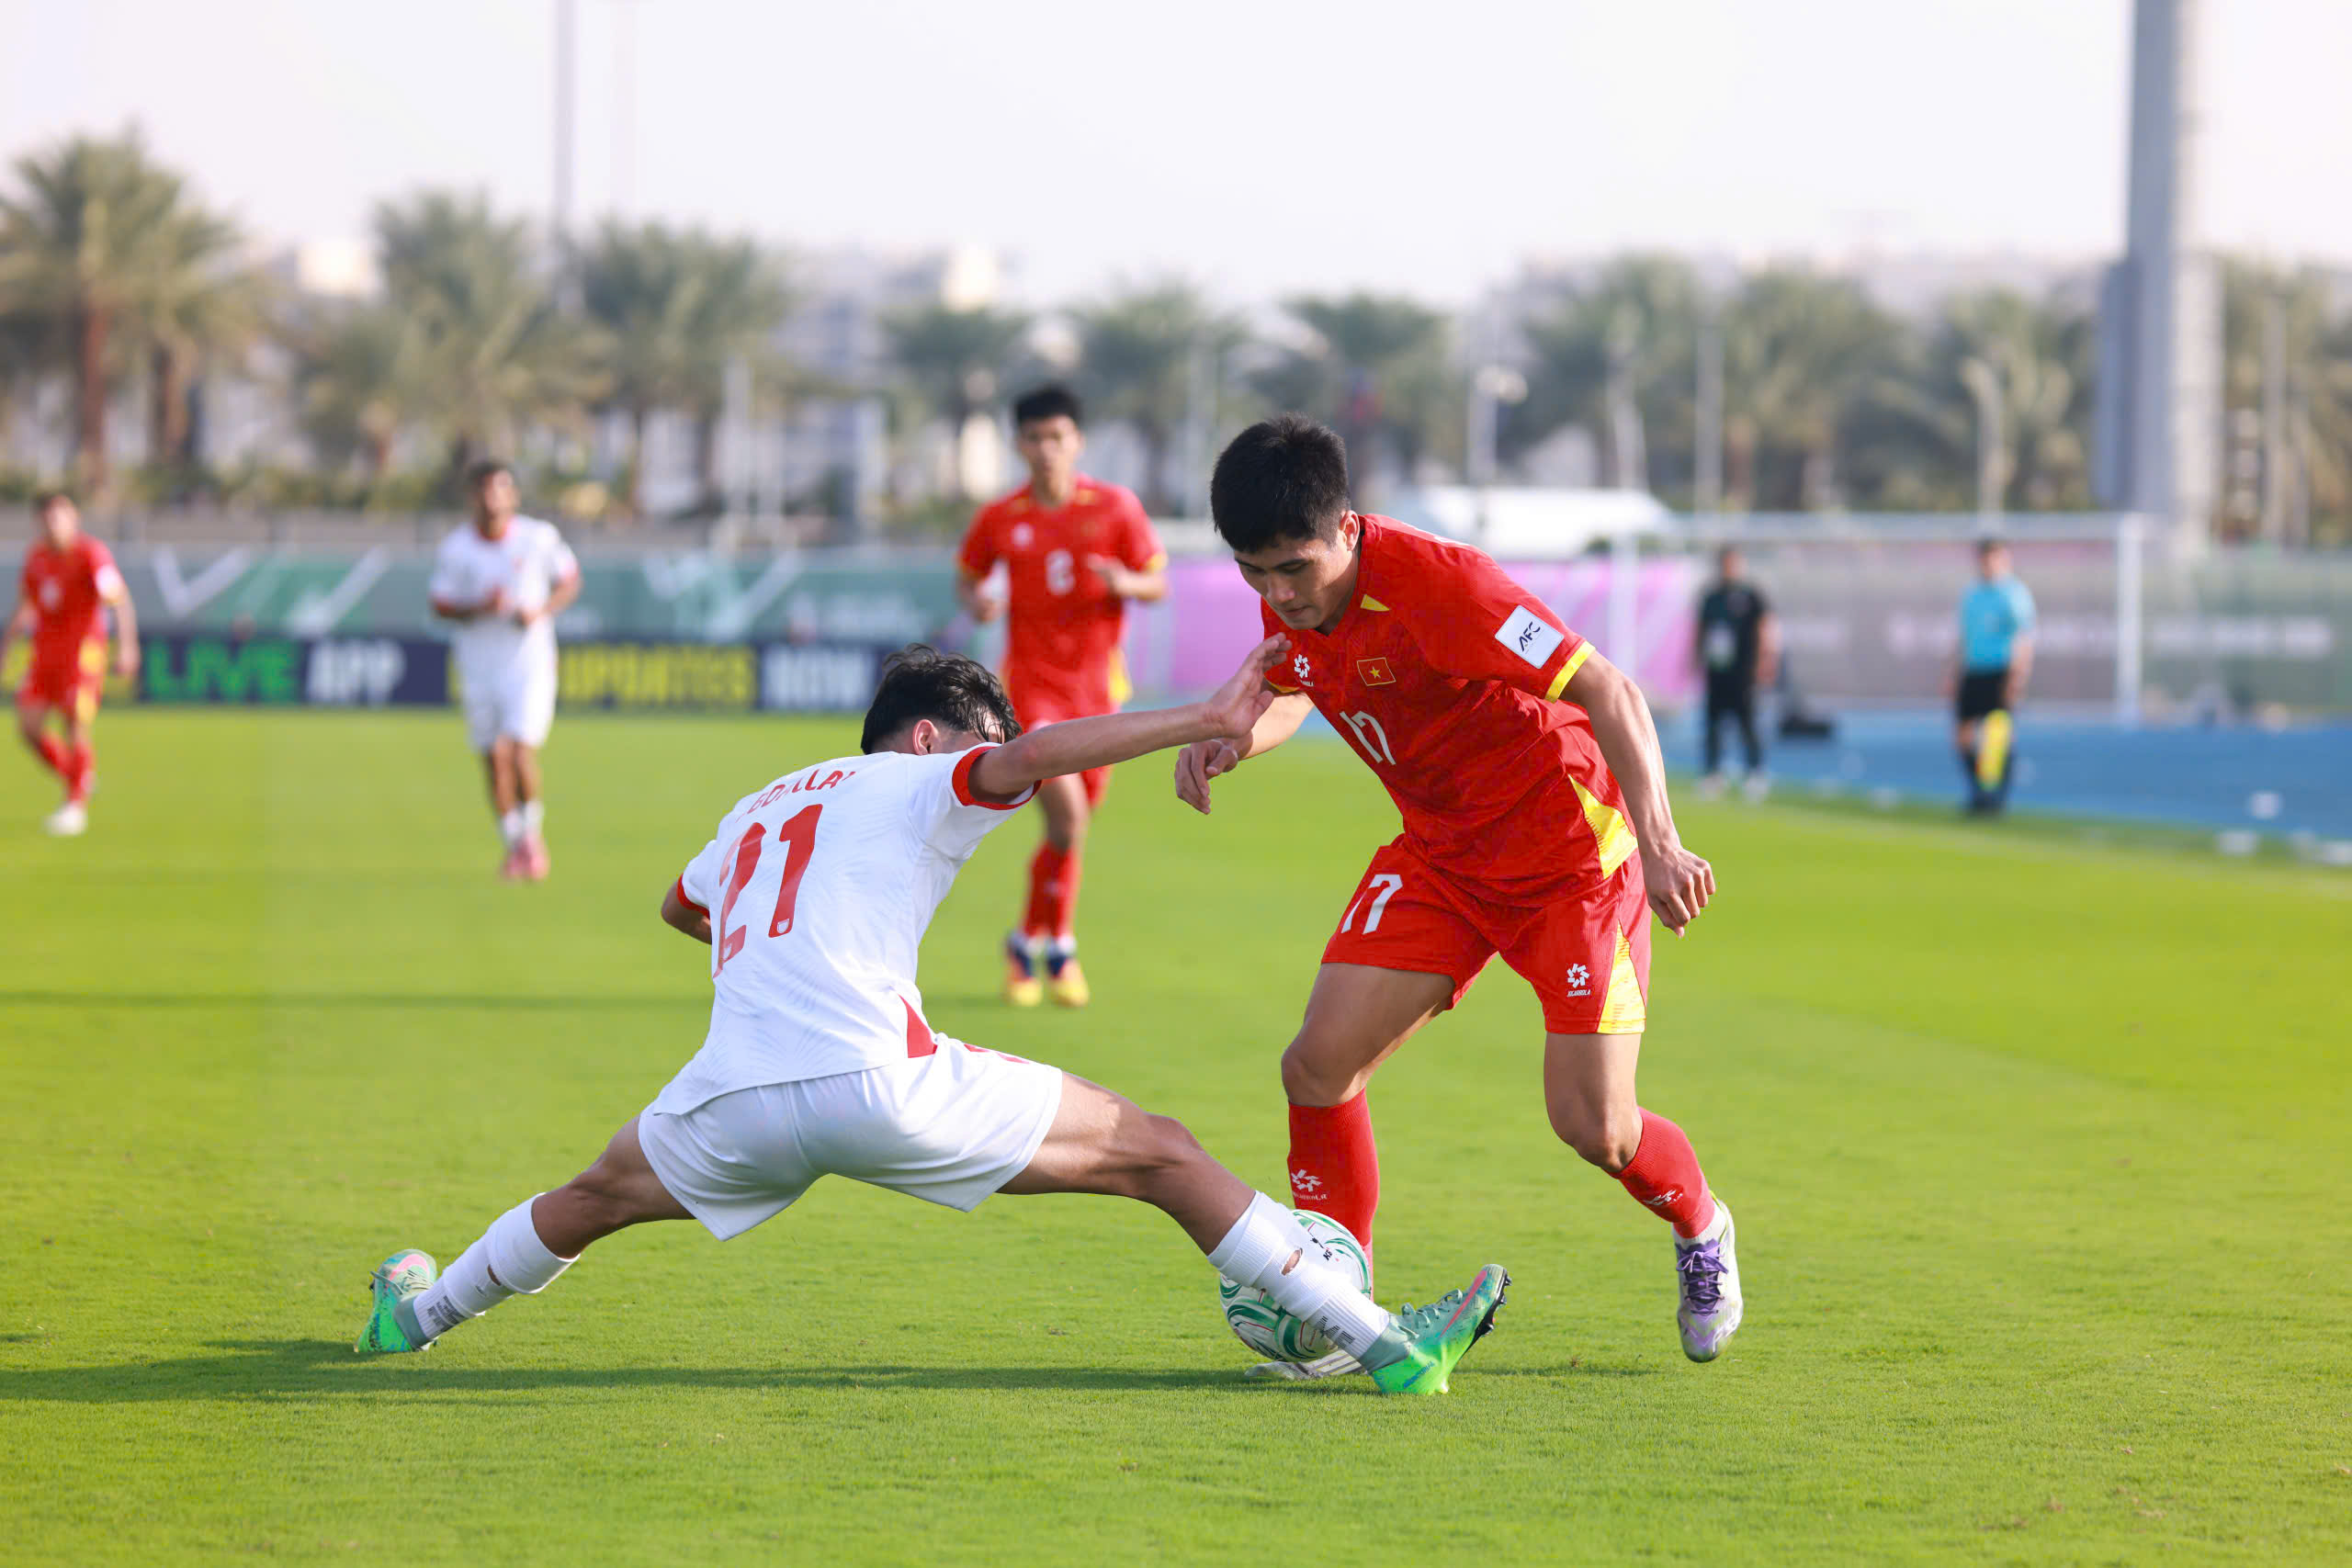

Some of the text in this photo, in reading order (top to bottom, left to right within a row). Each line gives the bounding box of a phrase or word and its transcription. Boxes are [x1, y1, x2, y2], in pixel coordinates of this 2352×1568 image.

[1519, 621, 1541, 652] AFC
[147, 640, 296, 702] LIVE
[309, 641, 404, 702] APP
[1339, 710, 1396, 765] 17
[712, 803, 823, 978] 21
